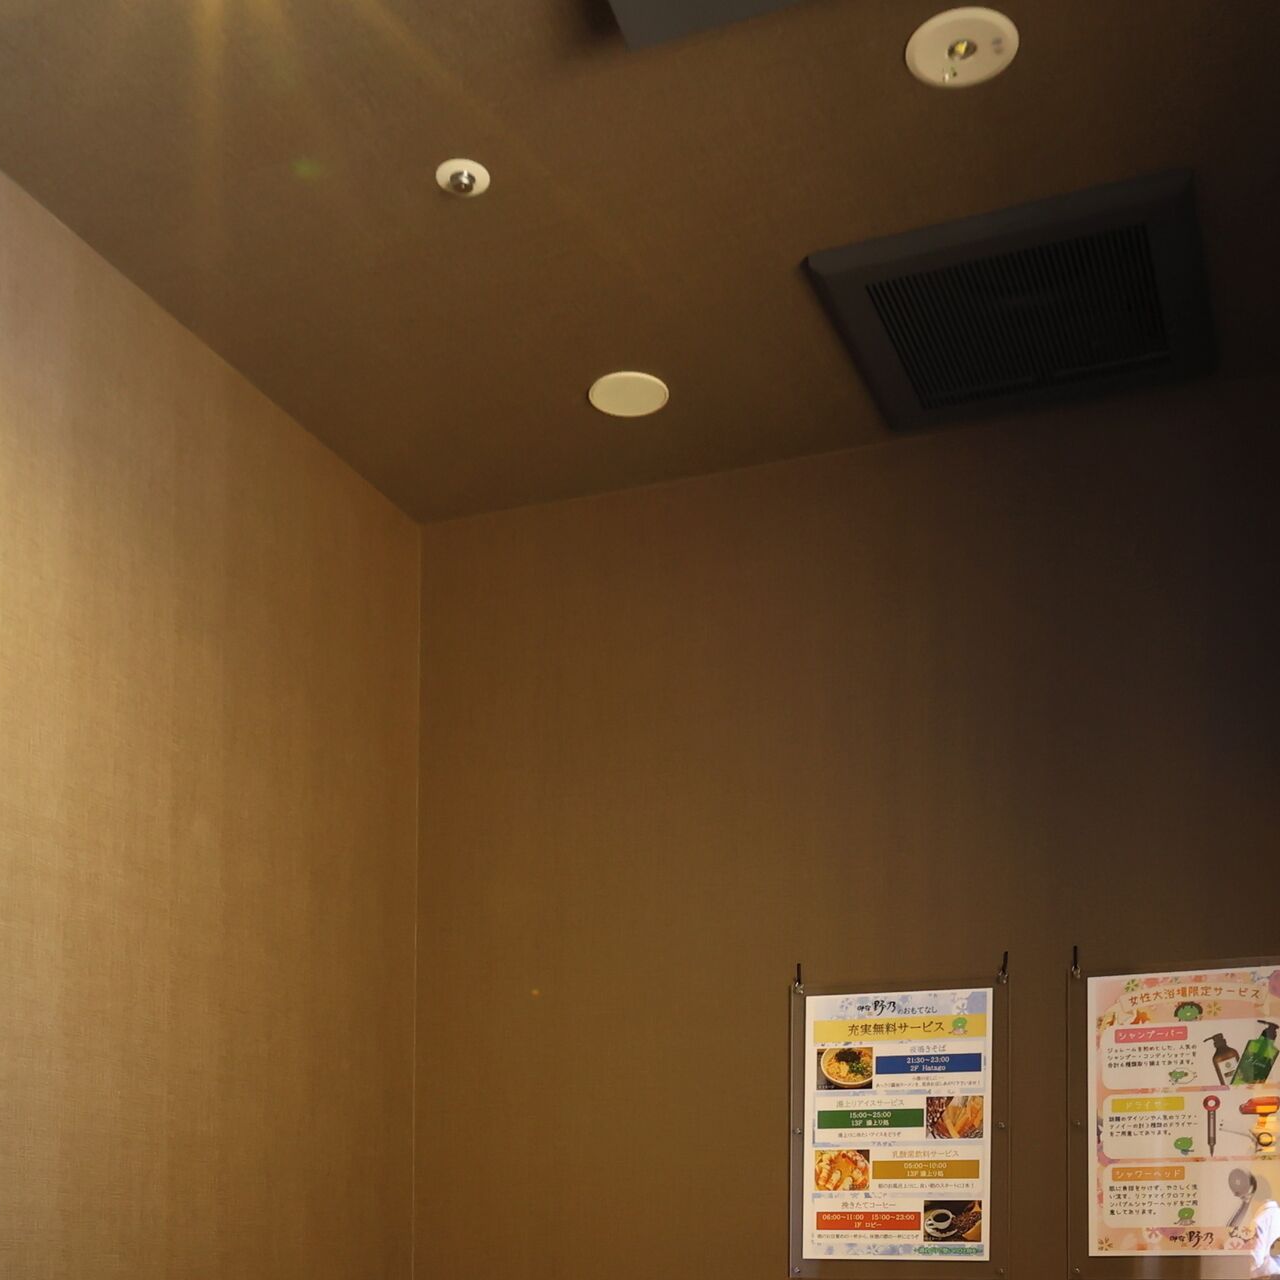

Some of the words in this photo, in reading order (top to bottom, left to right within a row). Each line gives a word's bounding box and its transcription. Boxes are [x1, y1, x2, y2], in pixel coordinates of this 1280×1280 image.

[1128, 985, 1263, 1006] 女性大浴場限定サービス
[847, 1021, 945, 1037] 充実無料サービス
[1119, 1030, 1185, 1040] シャンプーバー
[922, 1064, 947, 1072] Hatago
[1116, 1169, 1181, 1178] シャワーヘッド
